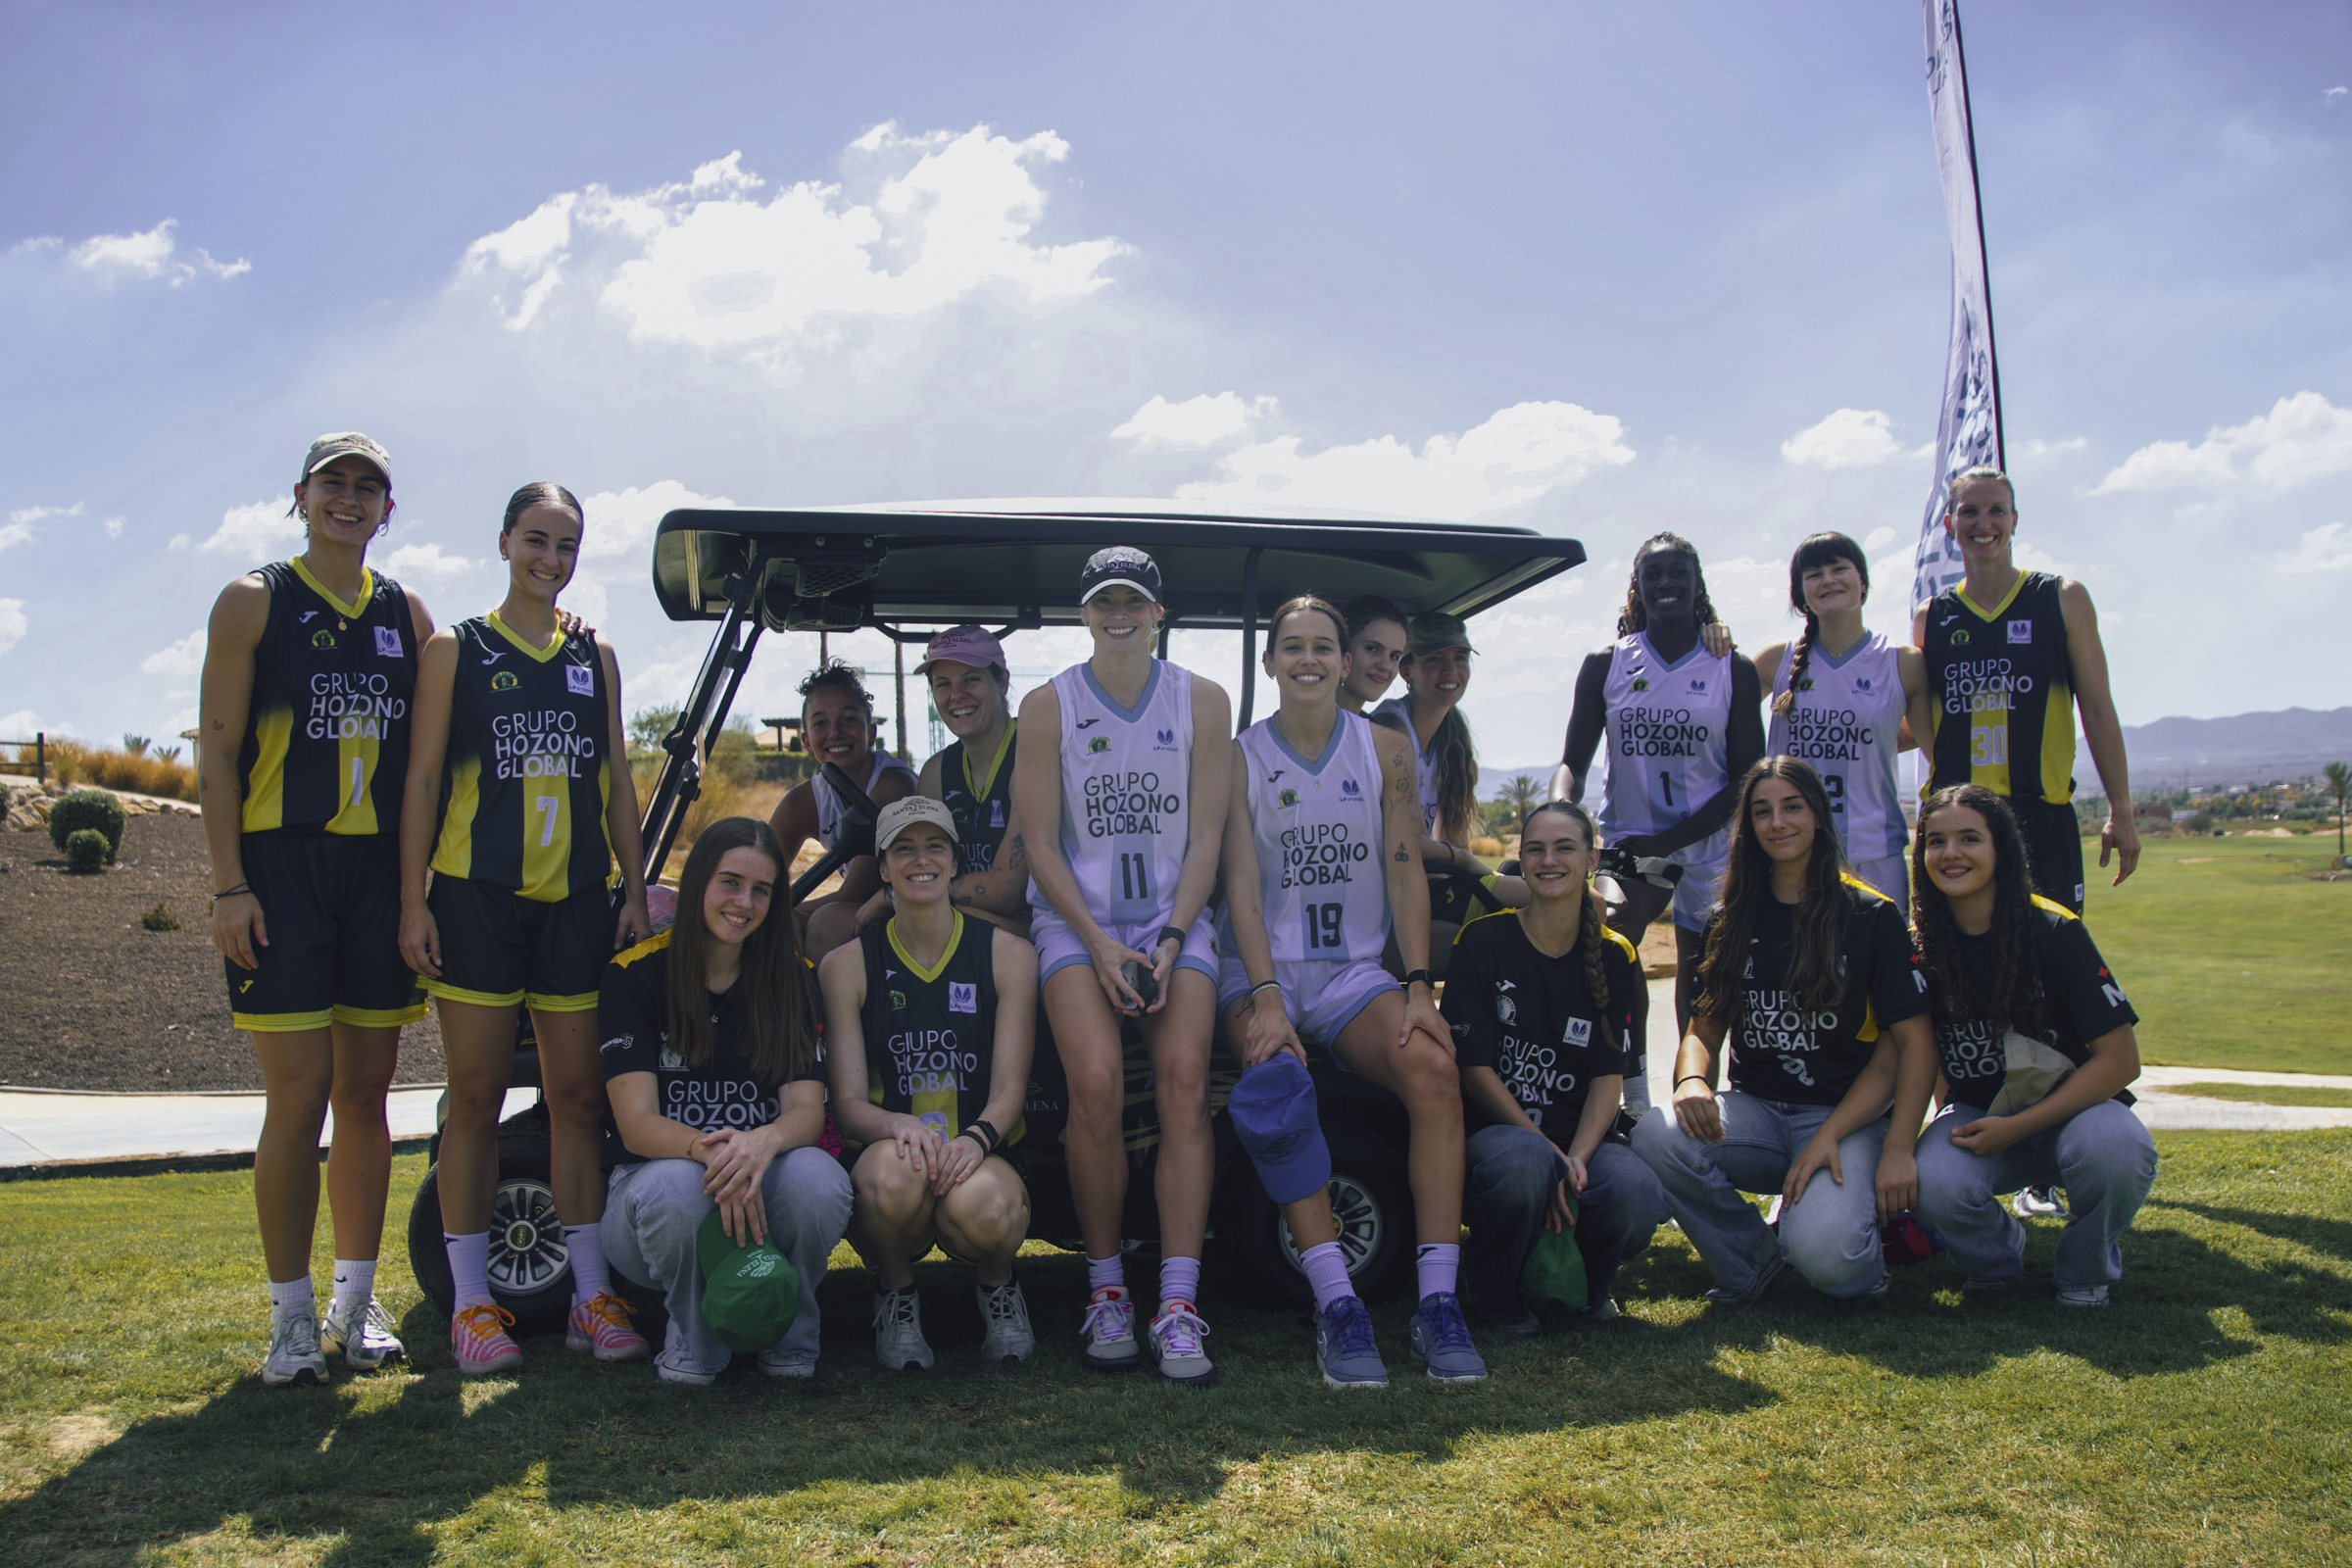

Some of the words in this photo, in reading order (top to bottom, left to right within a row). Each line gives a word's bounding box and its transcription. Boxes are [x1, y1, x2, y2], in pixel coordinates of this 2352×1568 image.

[1944, 658, 2012, 680] GRUPO
[1945, 674, 2034, 698] HOZONO
[1619, 707, 1690, 724] GRUPO
[1945, 693, 2017, 714] GLOBAL
[492, 710, 577, 737] GRUPO
[1787, 708, 1856, 726] GRUPO
[1620, 722, 1709, 742] HOZONO
[1788, 724, 1874, 745] HOZONO
[495, 732, 595, 760] HOZONO
[1621, 740, 1696, 757] GLOBAL
[1787, 742, 1861, 760] GLOBAL
[1971, 724, 2007, 766] 30
[497, 755, 582, 780] GLOBAL
[1084, 771, 1159, 797] GRUPO
[1659, 770, 1674, 807] 1
[1819, 773, 1844, 813] 2
[1085, 792, 1180, 817] HOZONO
[537, 796, 559, 847] 7
[1087, 813, 1162, 838] GLOBAL
[1280, 822, 1348, 850] GRUPO
[1283, 842, 1369, 869] HOZONO
[1120, 853, 1149, 900] 11
[1281, 863, 1353, 889] GLOBAL
[1305, 902, 1344, 949] 19
[1499, 1034, 1556, 1067] RUPO
[1743, 1029, 1821, 1052] GLOBAL
[1499, 1054, 1576, 1092] OZONO
[1947, 1054, 2007, 1079] GLO
[667, 1080, 759, 1103] GRUPO
[1504, 1079, 1553, 1105] OBAL
[666, 1097, 782, 1126] HOZONO
[1024, 1100, 1059, 1111] LENA
[735, 1259, 760, 1277] ELENA
